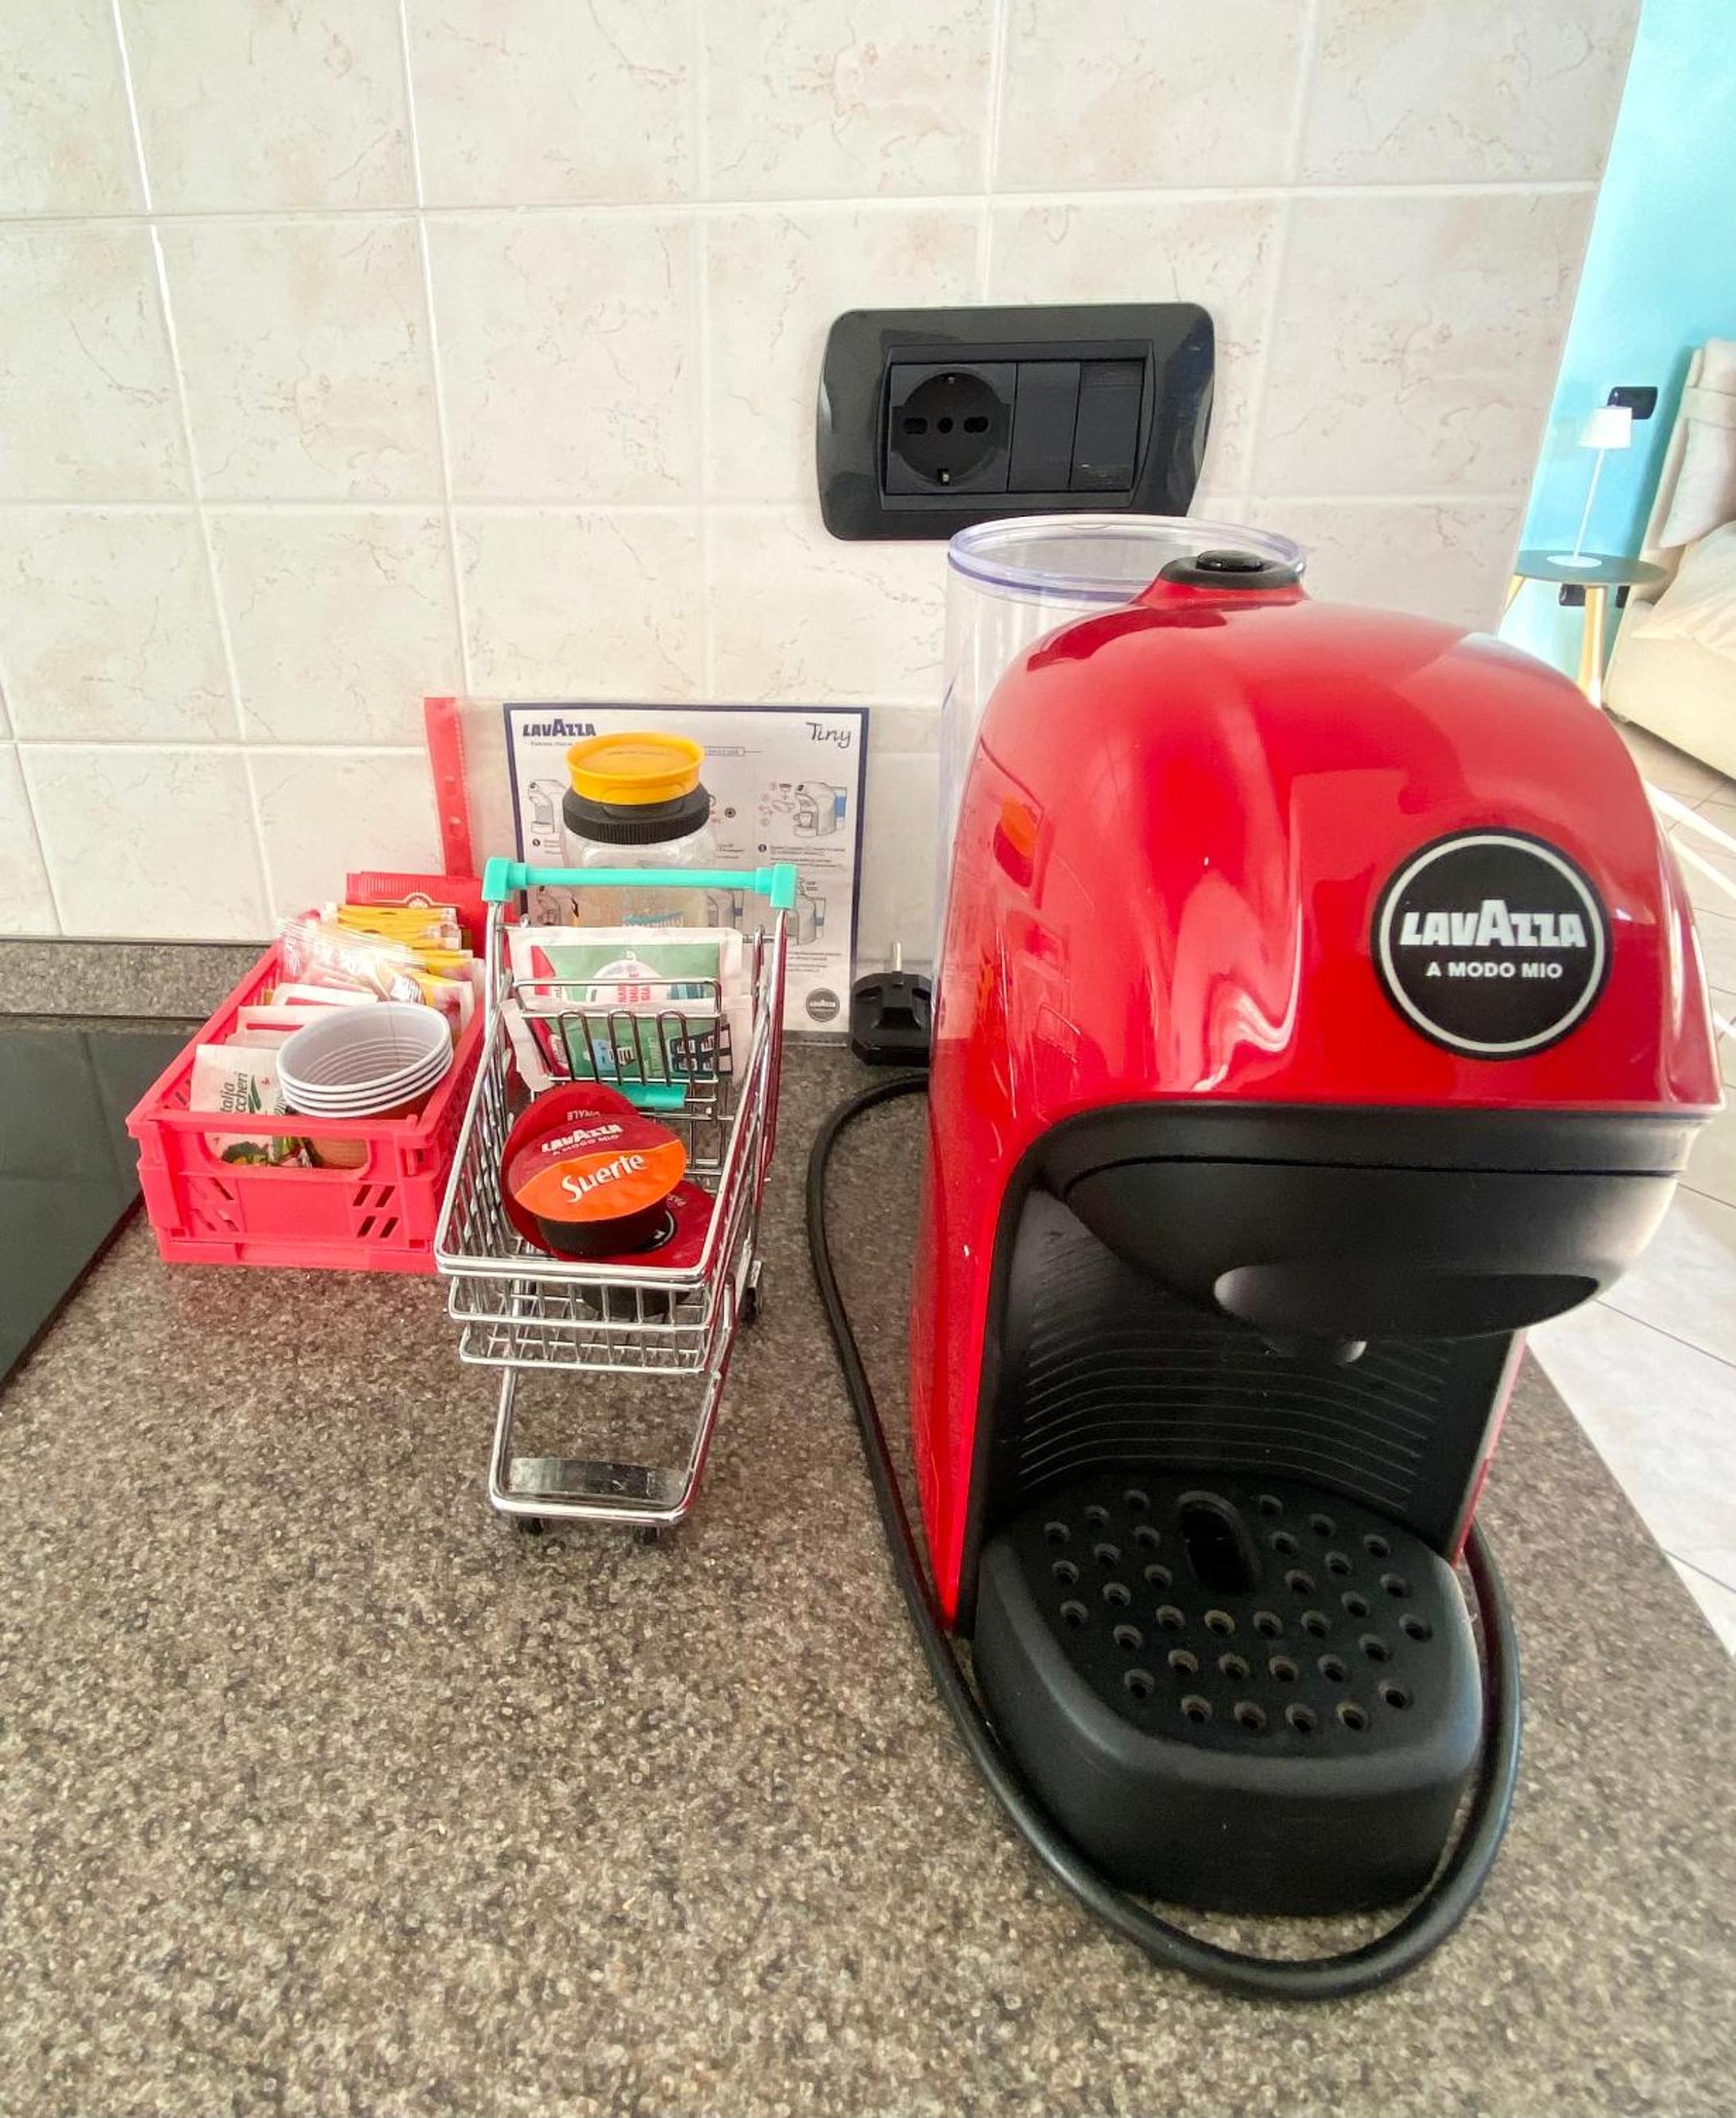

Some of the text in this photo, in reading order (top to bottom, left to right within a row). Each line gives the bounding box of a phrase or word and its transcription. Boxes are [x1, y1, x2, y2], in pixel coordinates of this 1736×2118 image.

[522, 718, 596, 737] LAVAZZA
[806, 722, 851, 749] Tiny
[1399, 899, 1587, 947] LAVAZZA
[1426, 962, 1563, 979] A MODO MIO
[219, 1082, 235, 1114] talia
[542, 1124, 624, 1153] LAVAZZA
[561, 1155, 647, 1203] Suerte
